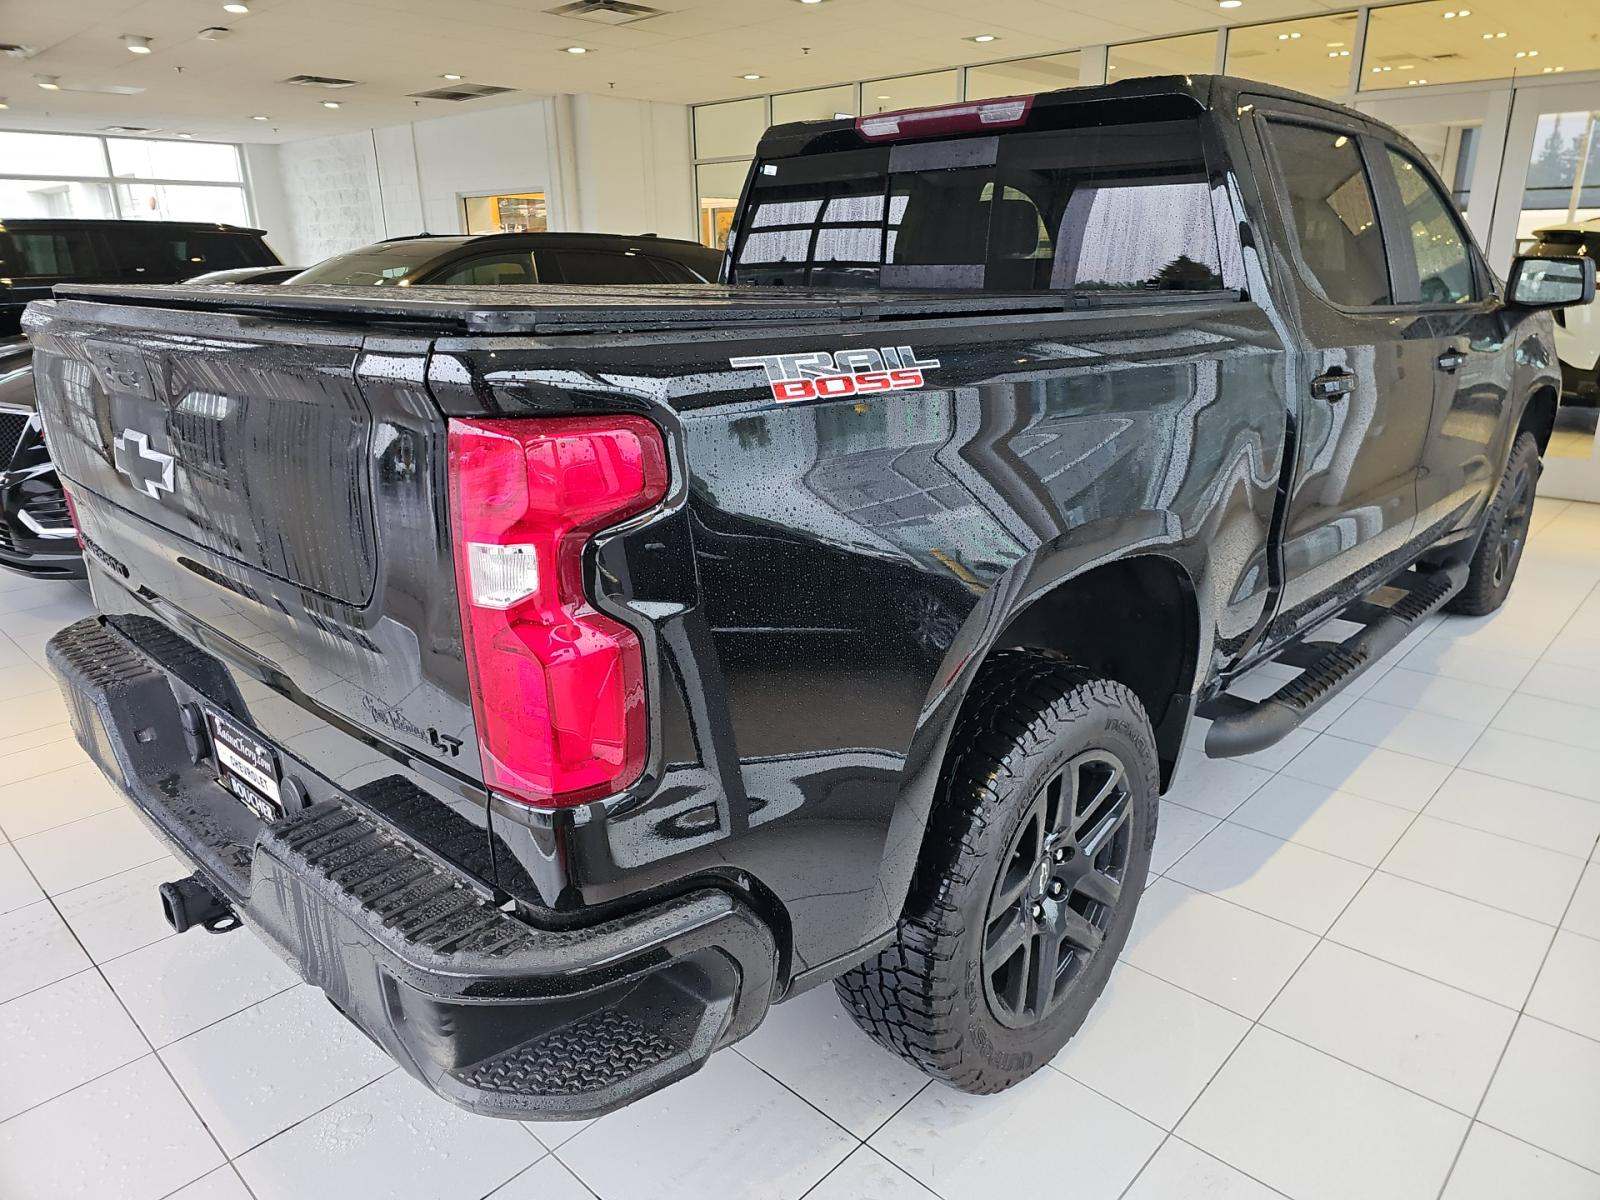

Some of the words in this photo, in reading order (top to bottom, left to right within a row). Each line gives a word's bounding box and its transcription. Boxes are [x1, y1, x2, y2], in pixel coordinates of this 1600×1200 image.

[728, 345, 941, 382] TRAIL
[770, 368, 925, 404] BOSS
[427, 727, 464, 757] LT
[229, 755, 269, 792] CHEVROLET
[230, 777, 275, 822] BOUCHER
